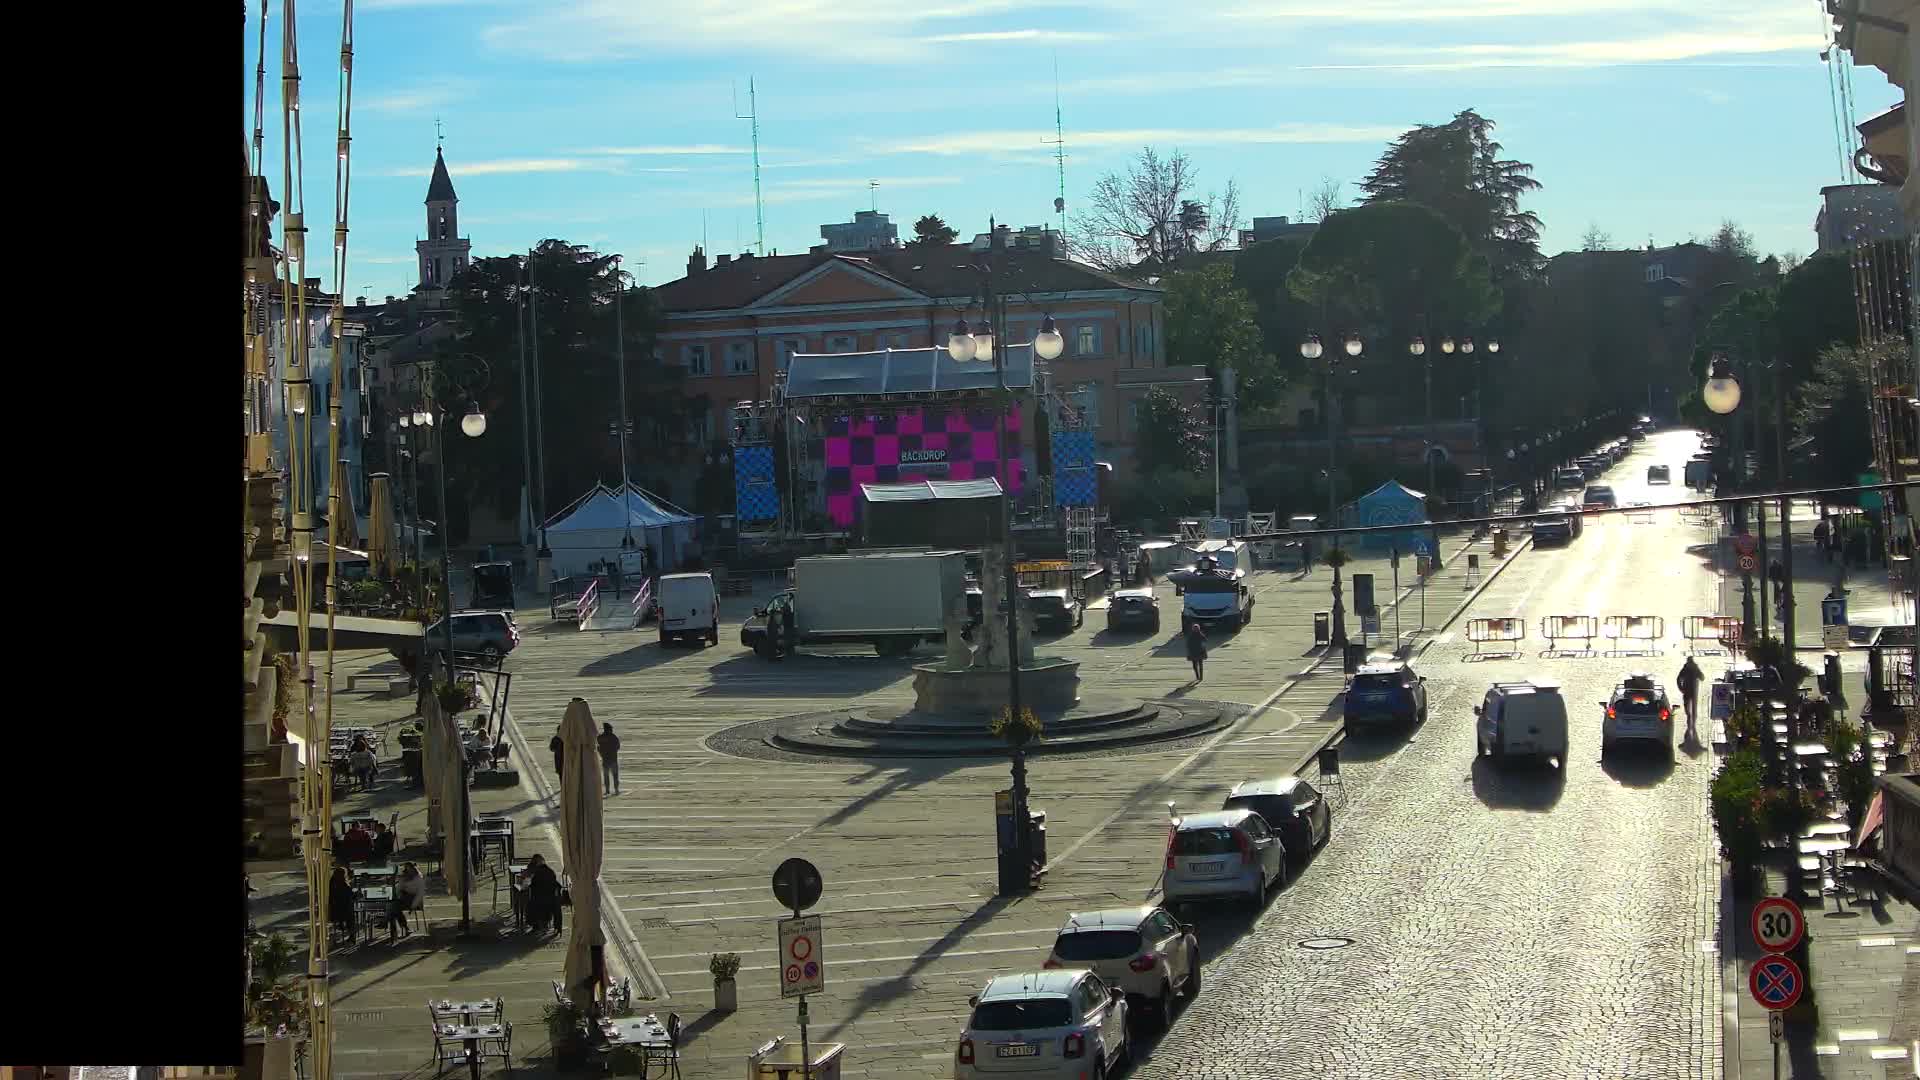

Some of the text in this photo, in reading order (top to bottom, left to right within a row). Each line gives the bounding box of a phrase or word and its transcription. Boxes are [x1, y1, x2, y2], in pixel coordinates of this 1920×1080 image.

[901, 449, 946, 462] BACKDROP
[1742, 558, 1753, 568] 20
[1826, 602, 1842, 625] P
[1762, 912, 1792, 938] 30
